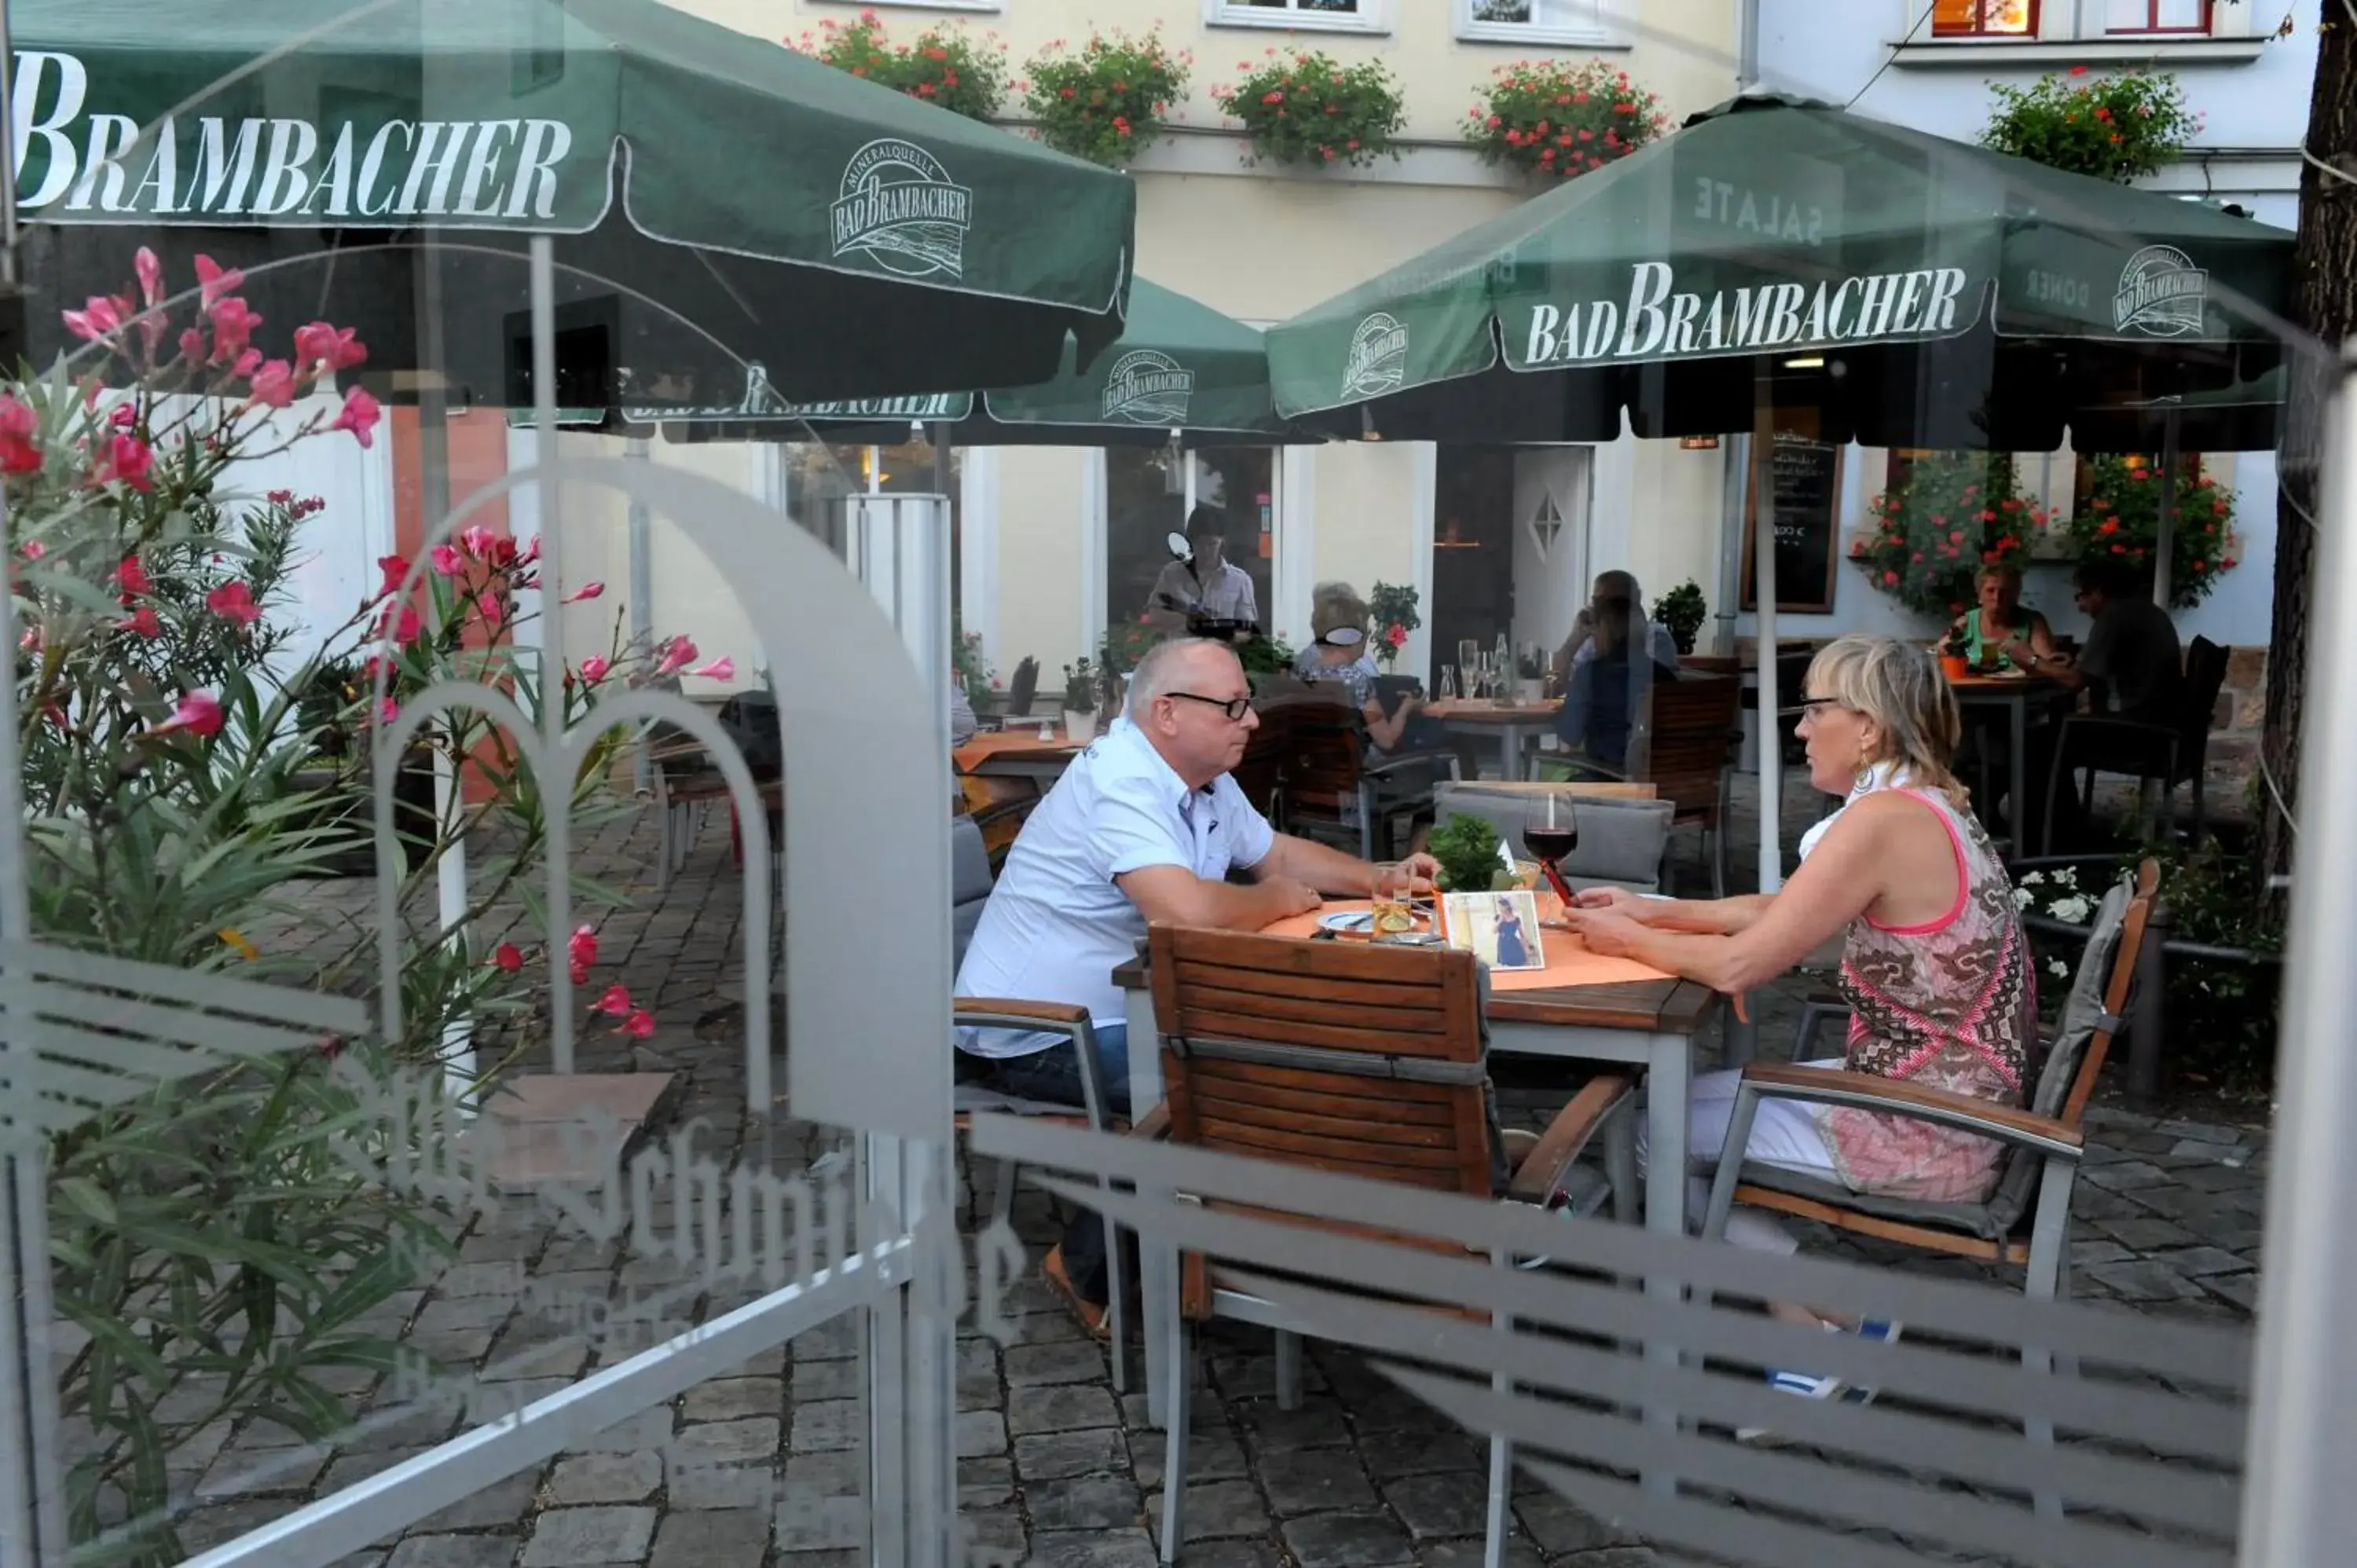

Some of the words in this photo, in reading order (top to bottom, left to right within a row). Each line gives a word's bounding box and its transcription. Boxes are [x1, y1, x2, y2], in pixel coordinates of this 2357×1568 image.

[9, 49, 572, 219] BRAMBACHER
[847, 145, 934, 188] MINERALQUELLE
[835, 198, 865, 244] BAD
[865, 174, 966, 228] BRAMBACHER
[1526, 301, 1618, 364] BAD
[1614, 262, 1966, 357] BRAMBACHER
